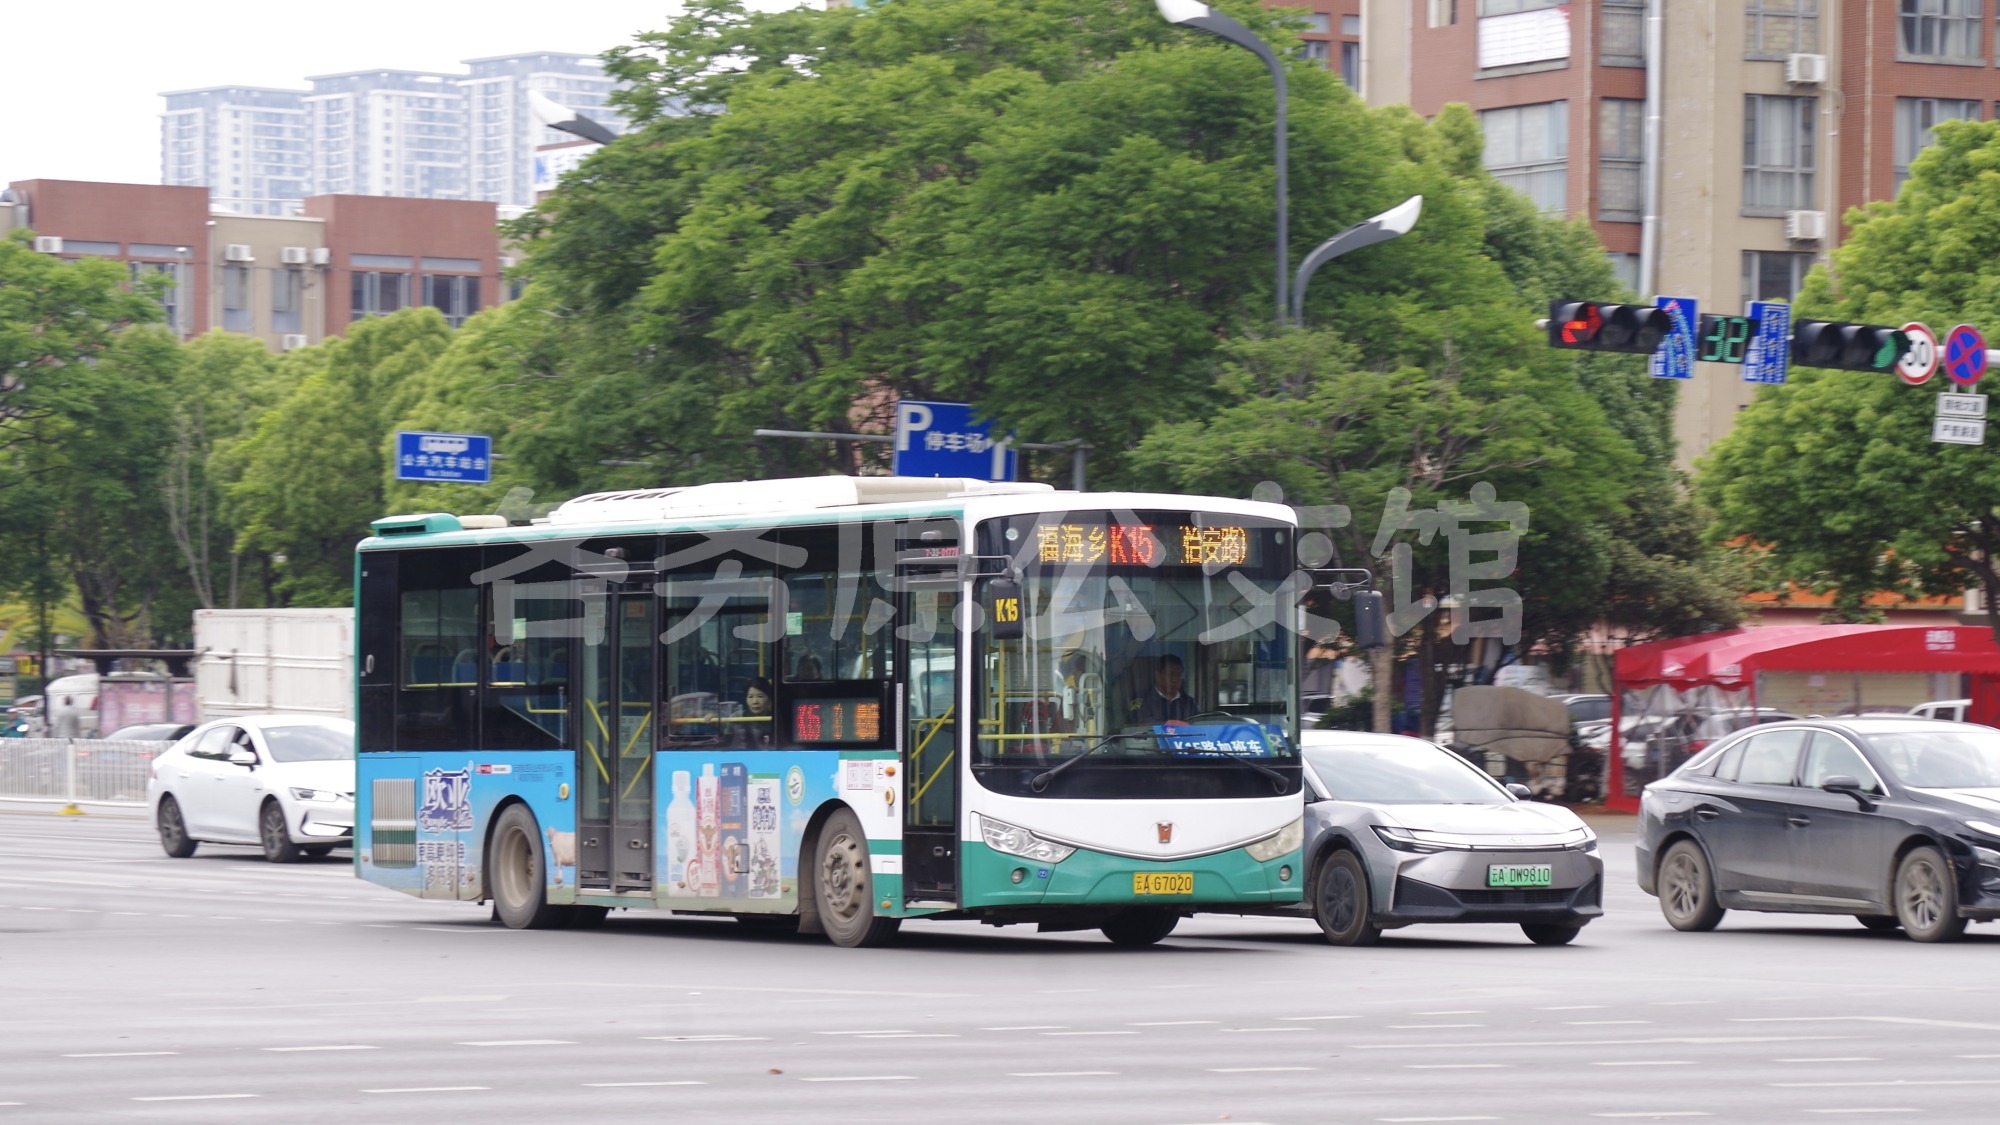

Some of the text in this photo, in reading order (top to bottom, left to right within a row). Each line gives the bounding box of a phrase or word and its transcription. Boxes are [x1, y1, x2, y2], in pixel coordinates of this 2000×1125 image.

[1702, 316, 1749, 363] 32
[898, 404, 933, 451] P
[923, 430, 984, 454] 停车场
[1037, 525, 1107, 563] 福海乡
[1111, 526, 1154, 564] K15
[995, 598, 1019, 623] K15
[424, 770, 470, 811] 欧亚
